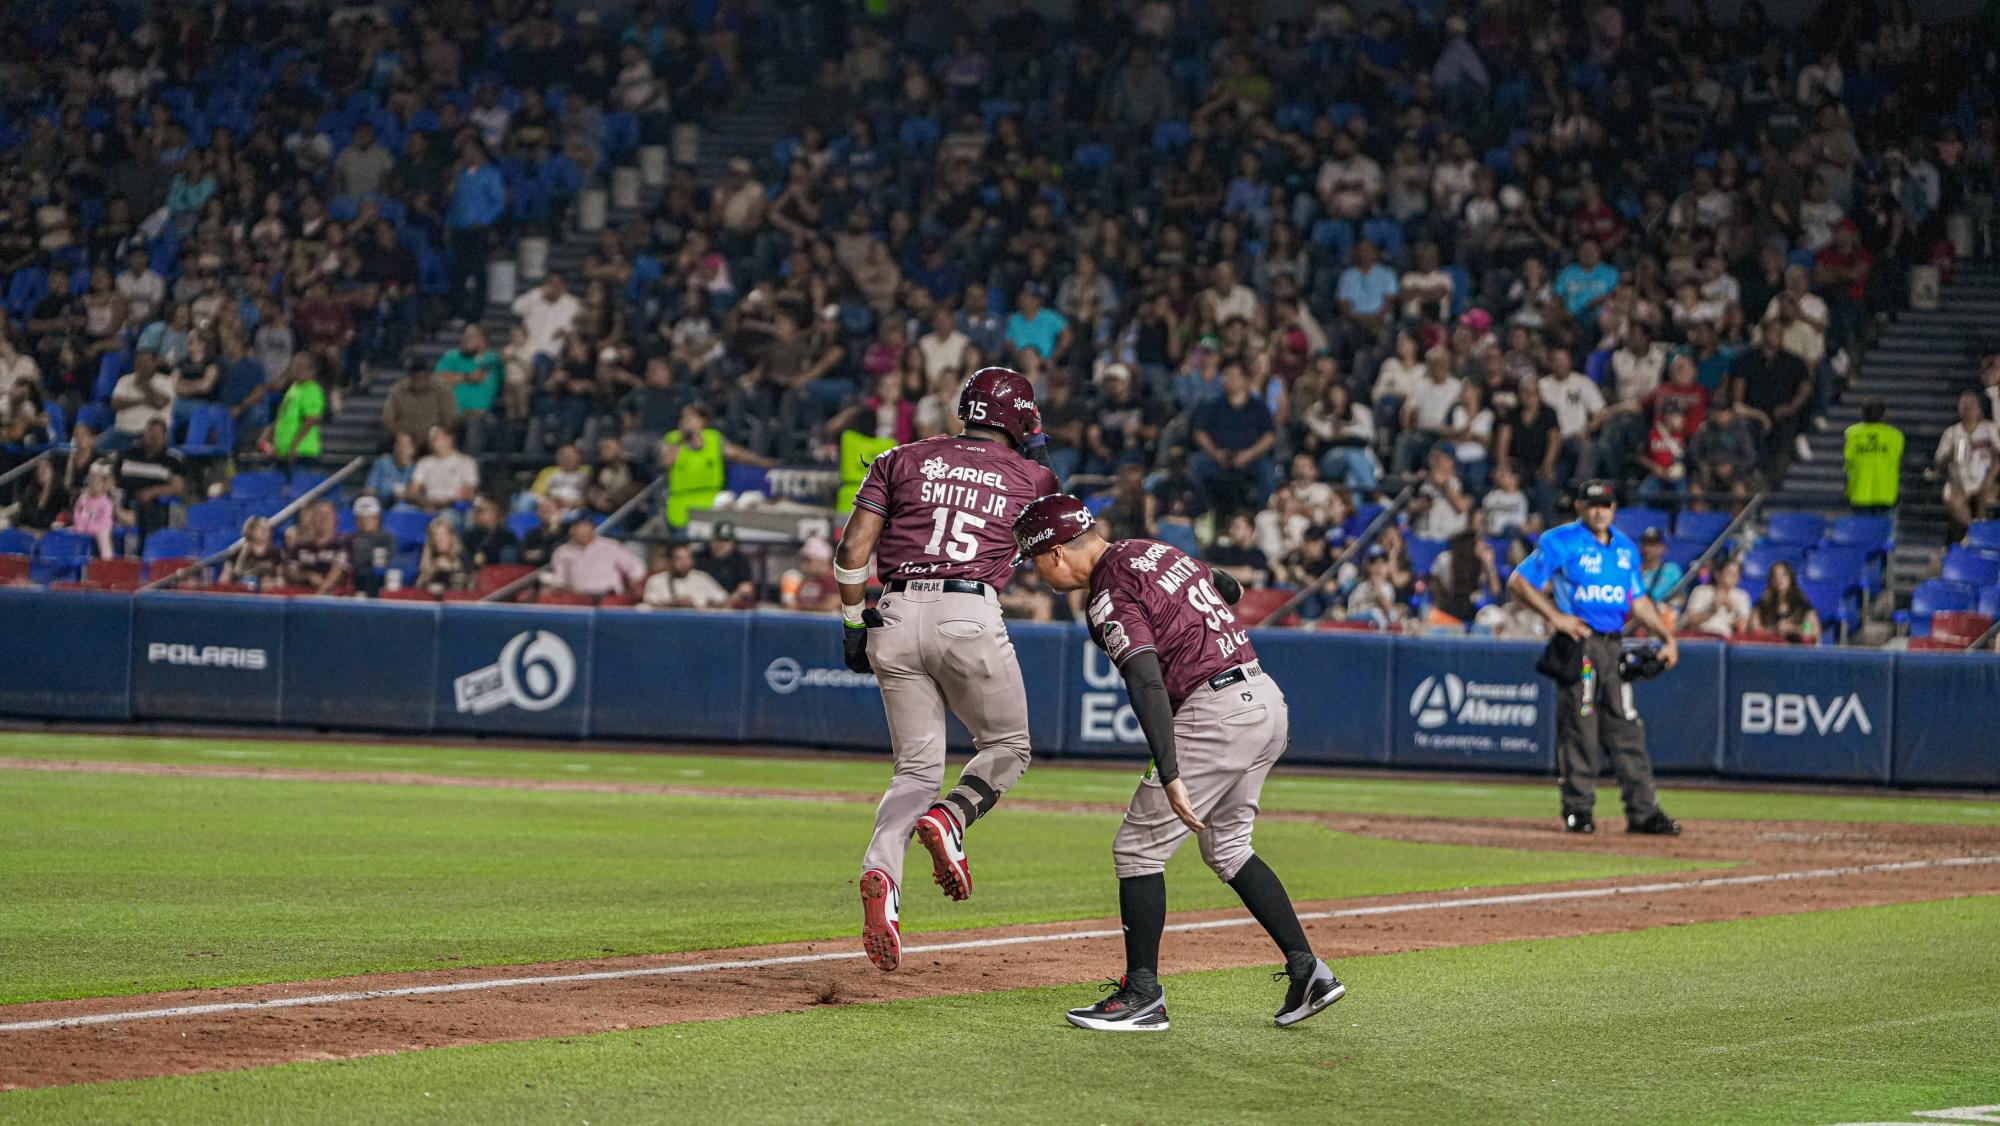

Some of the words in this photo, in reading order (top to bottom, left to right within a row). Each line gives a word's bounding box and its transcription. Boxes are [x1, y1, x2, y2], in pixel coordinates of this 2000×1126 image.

[968, 400, 988, 420] 15
[947, 466, 1007, 491] ARIEL
[920, 481, 979, 509] SMITH
[981, 493, 1007, 518] JR
[1076, 506, 1096, 529] 99
[924, 507, 986, 562] 15
[911, 581, 923, 591] NEW
[1574, 584, 1625, 604] ARCO
[1188, 578, 1234, 632] 99
[148, 642, 267, 669] POLARIS
[1456, 698, 1538, 726] Ahorro
[1741, 692, 1872, 736] BBVA
